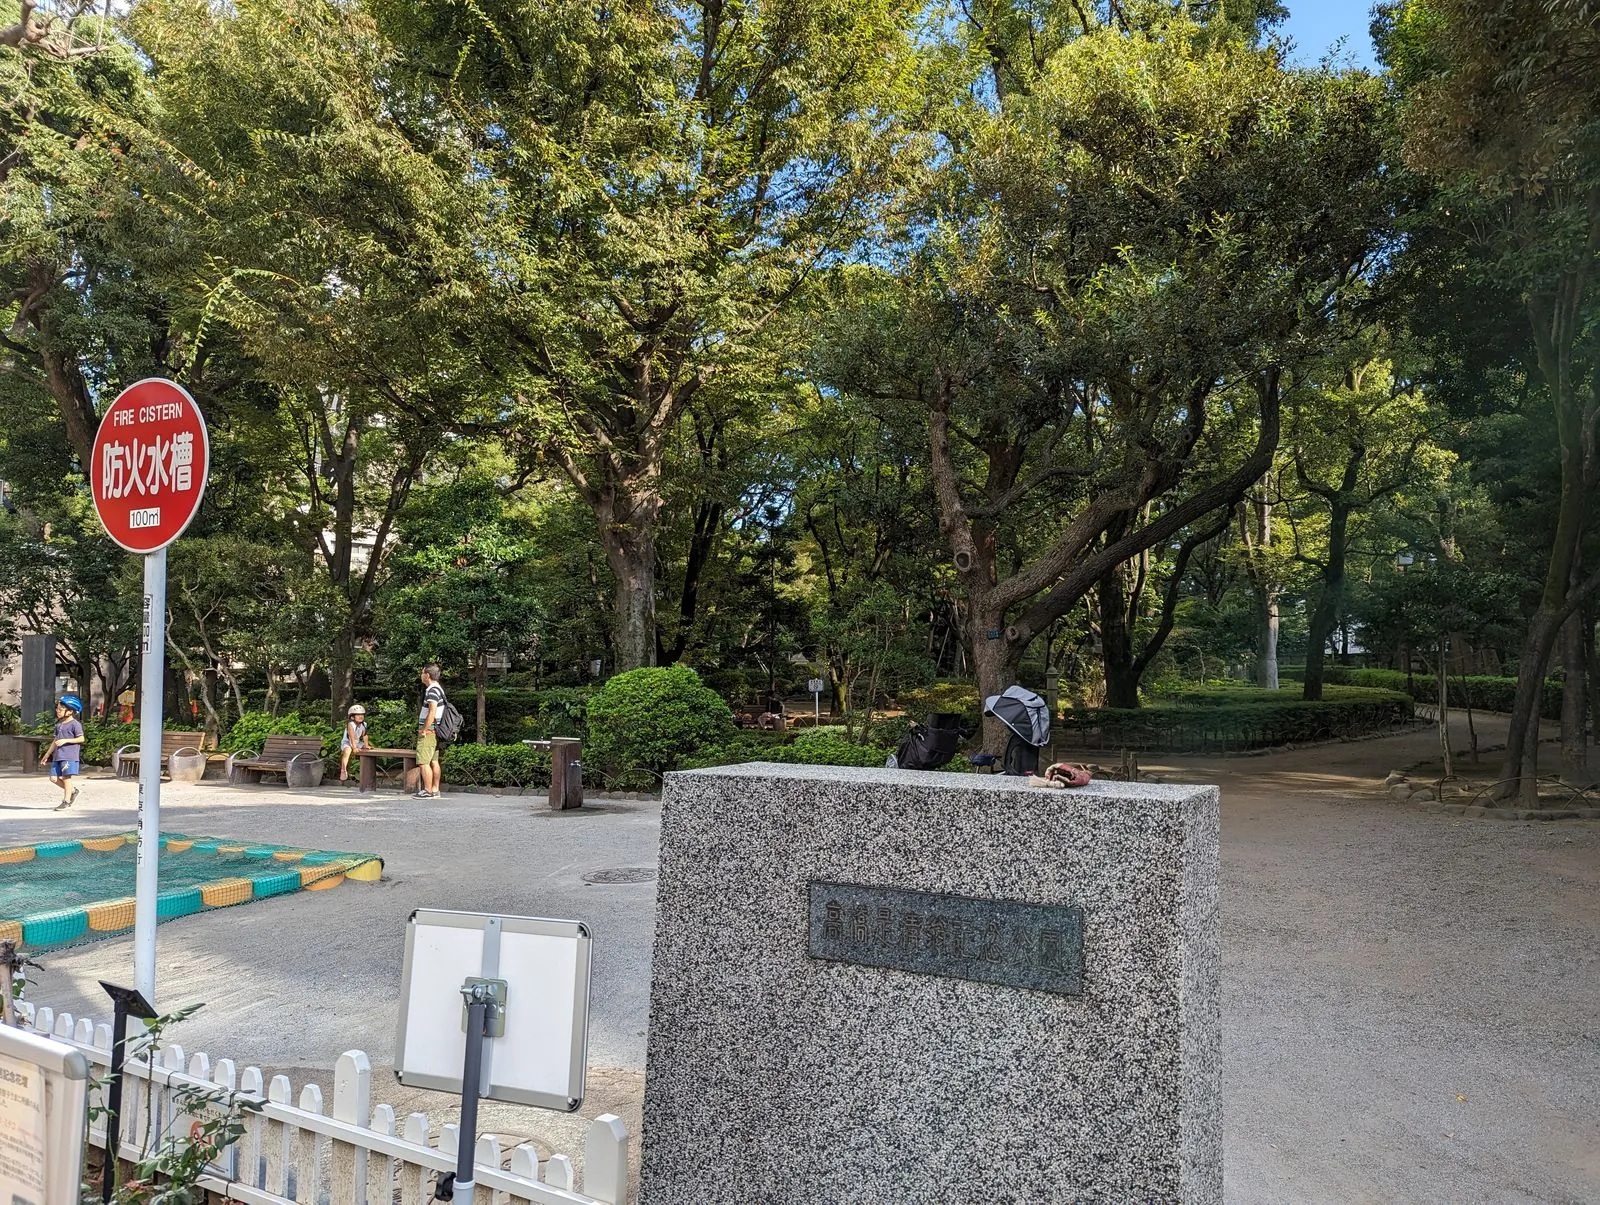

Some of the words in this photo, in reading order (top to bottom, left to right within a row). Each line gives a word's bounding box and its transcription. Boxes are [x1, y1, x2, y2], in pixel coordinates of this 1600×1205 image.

[113, 409, 135, 427] FIRE
[139, 402, 183, 424] CISTERN
[102, 431, 194, 500] 防火水槽
